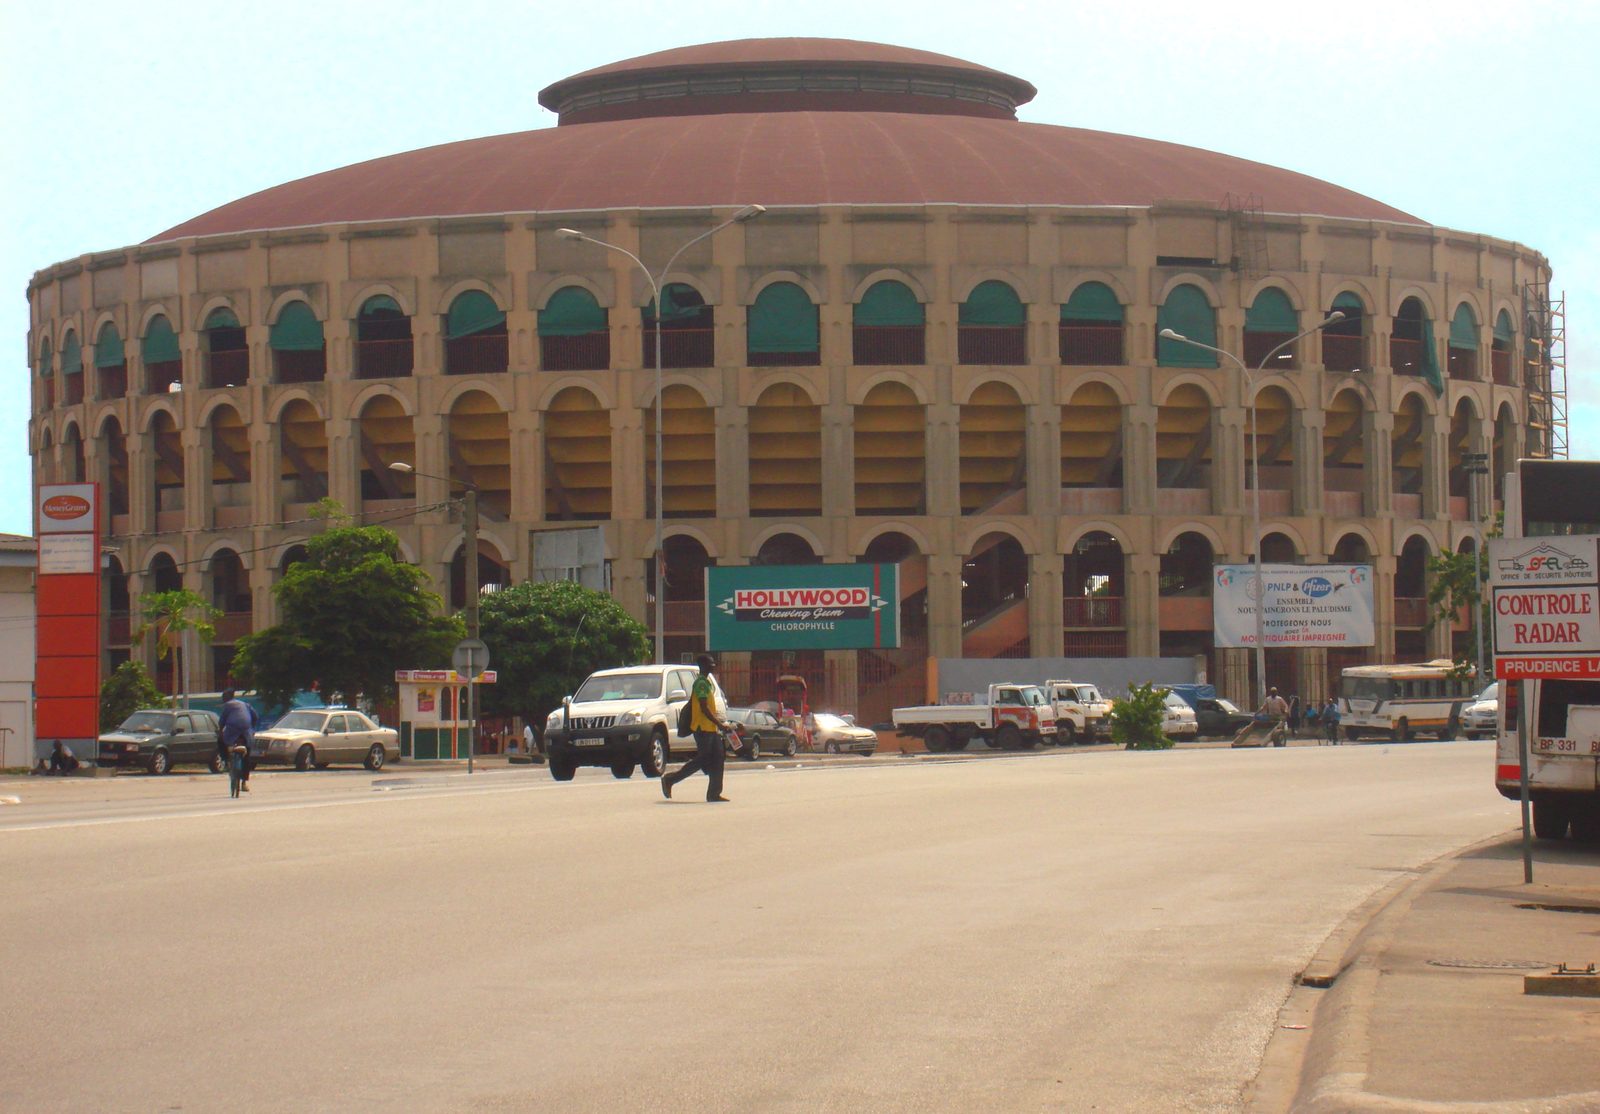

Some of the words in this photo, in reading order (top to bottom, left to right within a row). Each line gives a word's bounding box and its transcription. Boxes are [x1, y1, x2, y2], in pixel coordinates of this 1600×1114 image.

[1534, 571, 1562, 579] SECURITE
[1267, 582, 1291, 592] PNLP
[1292, 583, 1299, 592] &
[1303, 579, 1330, 596] Pfizer
[737, 588, 867, 607] HOLLYWOOD
[1276, 598, 1314, 606] ENSEMBLE
[1261, 606, 1300, 614] AINCRONS
[1496, 593, 1592, 616] CONTROLE
[760, 608, 811, 620] Chewing
[813, 607, 844, 620] Gum
[770, 622, 835, 631] CHLOROPHYLLE
[1513, 622, 1582, 644] RADAR
[1504, 660, 1581, 673] PRUDENCE
[1540, 739, 1553, 750] BP
[1558, 740, 1576, 751] 331
